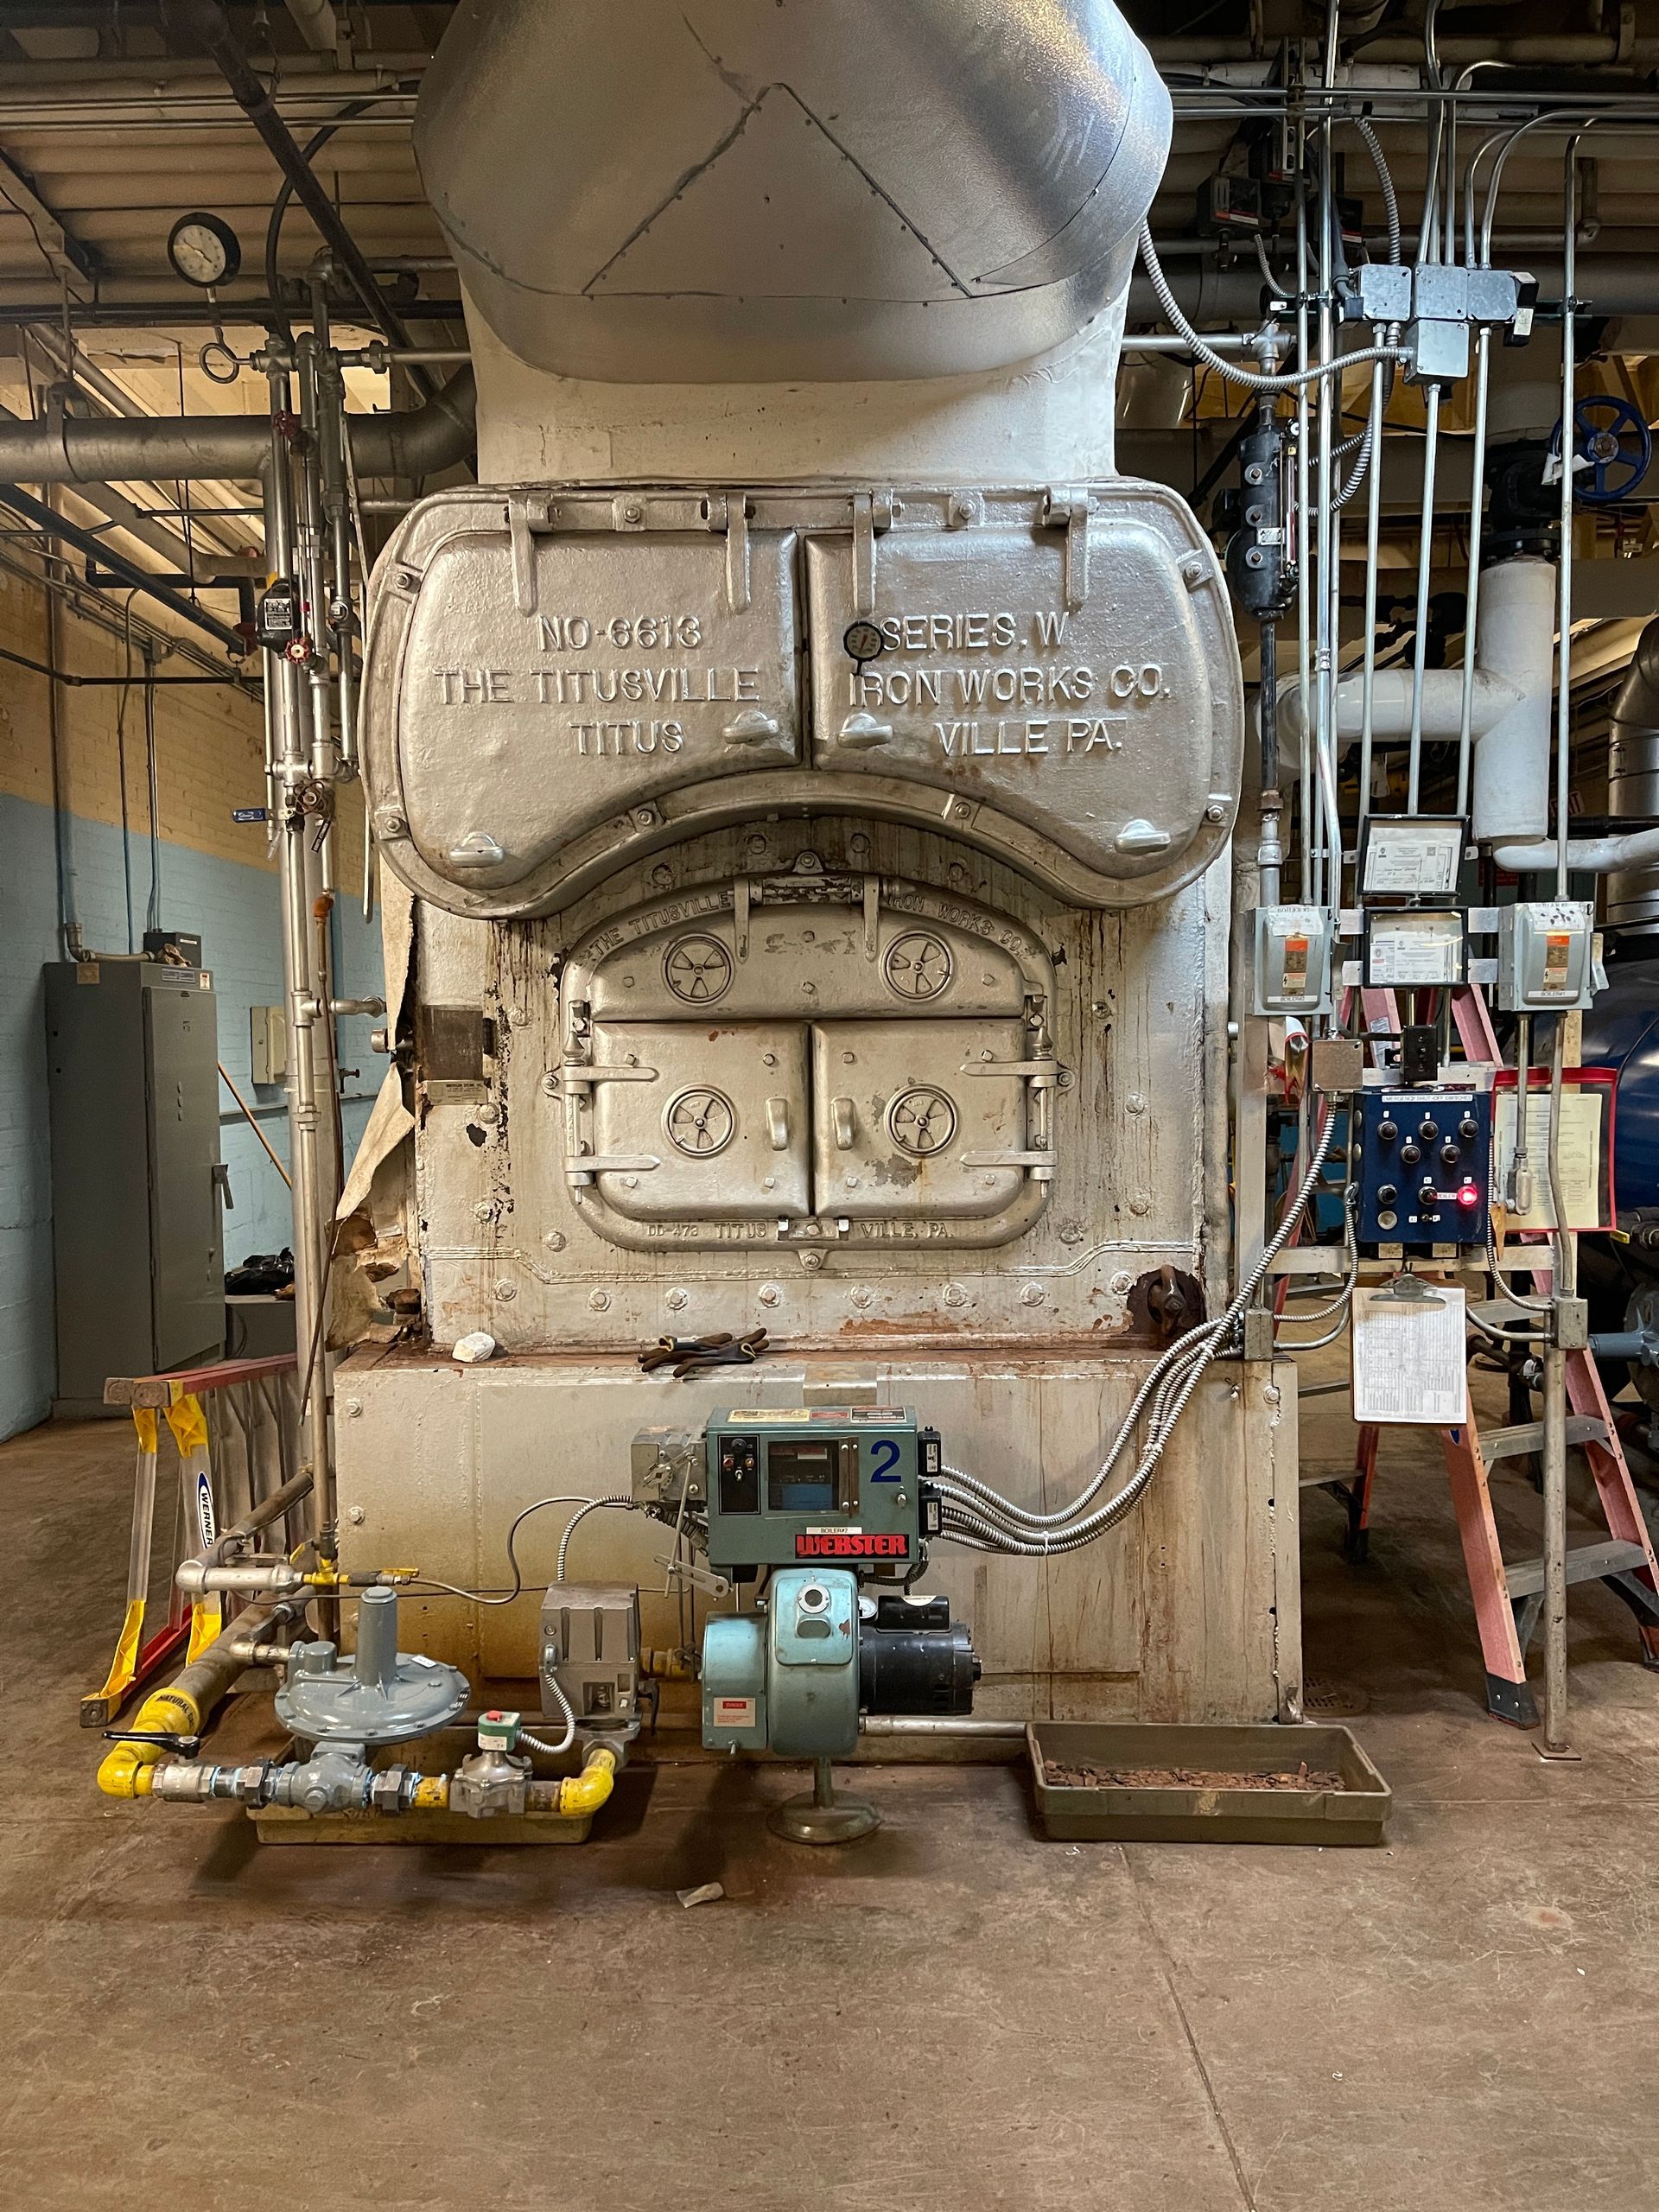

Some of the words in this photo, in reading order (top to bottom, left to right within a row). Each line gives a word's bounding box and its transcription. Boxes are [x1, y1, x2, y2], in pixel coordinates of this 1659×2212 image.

[1036, 610, 1070, 648] W
[434, 668, 513, 704] THE
[530, 666, 760, 702] TITUSVILLE
[849, 668, 942, 706] IRON
[957, 666, 1094, 705] WORKS
[1109, 663, 1172, 699] CO.
[567, 719, 685, 755] TITUS
[933, 720, 1050, 756] VILLE
[1065, 717, 1124, 753] PA.
[589, 927, 625, 956] THE
[628, 891, 731, 935] TITUSVILLE
[938, 901, 995, 936] WORKS
[714, 1223, 766, 1239] TITUS
[870, 1440, 901, 1483] 2
[201, 1492, 213, 1545] WERNER
[797, 1535, 907, 1554] WEBSTER
[156, 1694, 189, 1713] NATURAL
